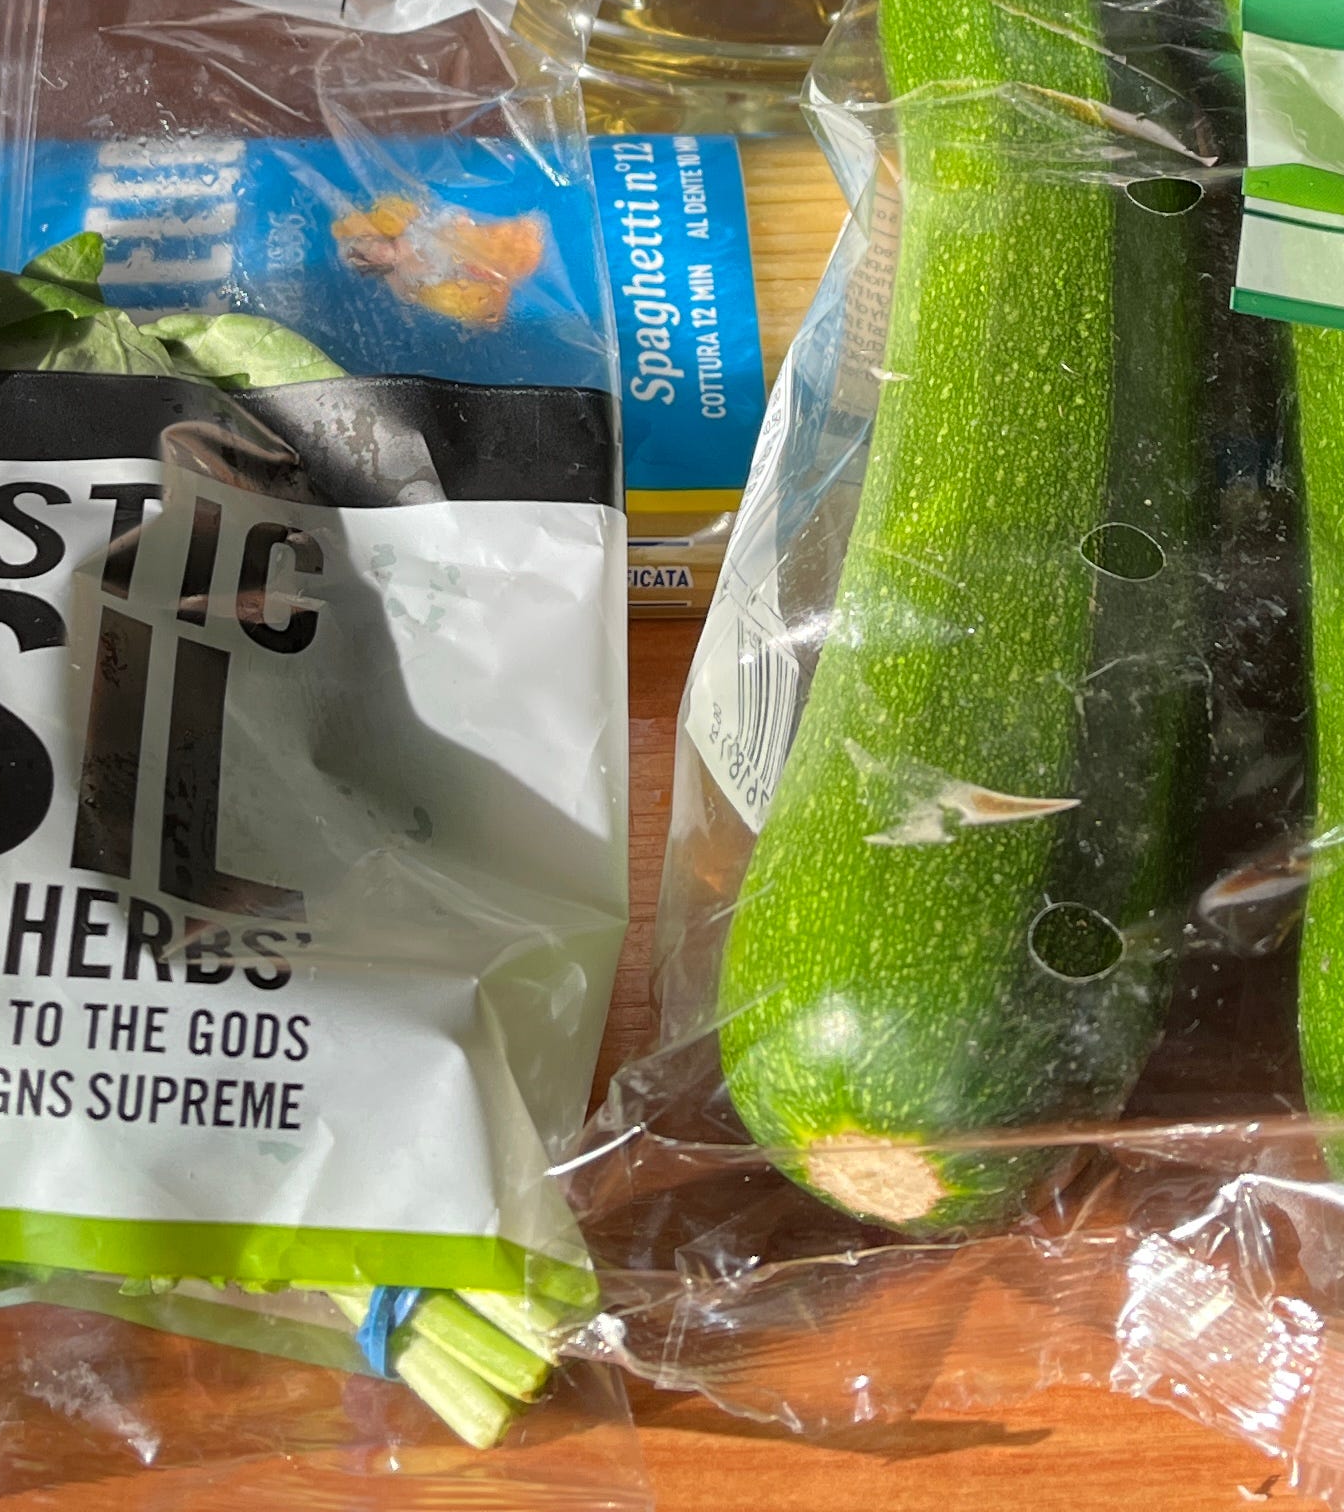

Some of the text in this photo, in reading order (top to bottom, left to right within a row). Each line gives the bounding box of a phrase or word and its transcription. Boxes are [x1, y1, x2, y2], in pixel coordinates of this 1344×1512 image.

[676, 153, 701, 168] 10
[679, 169, 707, 214] DENTE
[686, 219, 711, 240] AL
[614, 198, 685, 406] Spaghetti
[687, 264, 716, 301] MIN
[690, 307, 717, 329] 12
[695, 332, 727, 420] COTTURA
[628, 569, 689, 587] ICATA
[9, 999, 64, 1048] TO
[83, 1002, 168, 1054] THE
[188, 1008, 312, 1062] GODS
[85, 1072, 305, 1131] SUPREME
